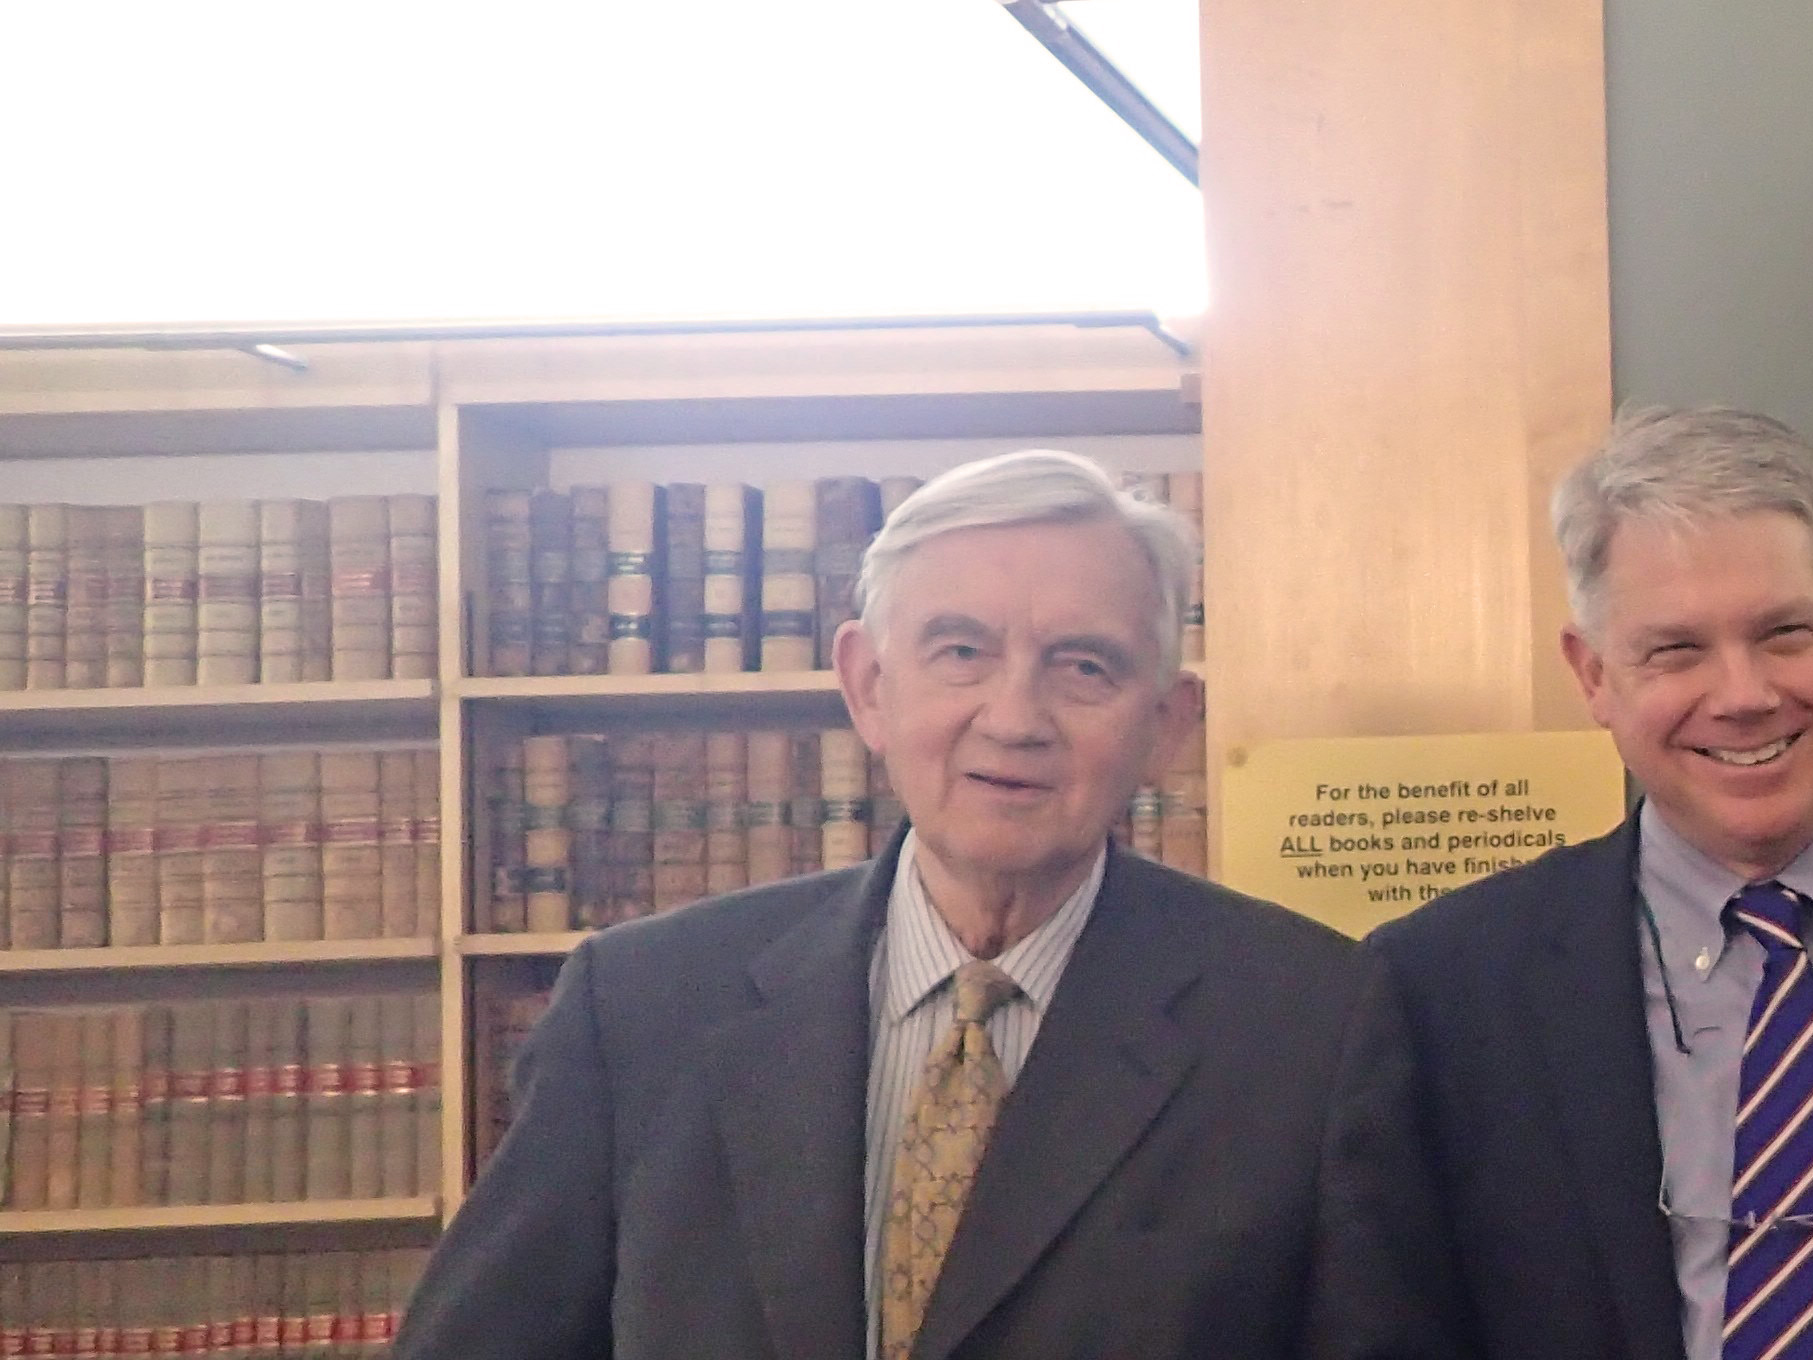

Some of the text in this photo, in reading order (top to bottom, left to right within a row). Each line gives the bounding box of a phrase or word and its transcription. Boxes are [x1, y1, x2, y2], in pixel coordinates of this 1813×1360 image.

[1315, 779, 1530, 801] For the benefit of all
[1289, 805, 1557, 829] readers, please re-shelve
[1280, 830, 1567, 858] ALL books and periodicals
[1297, 857, 1535, 882] when you have finish
[1368, 884, 1412, 903] with
